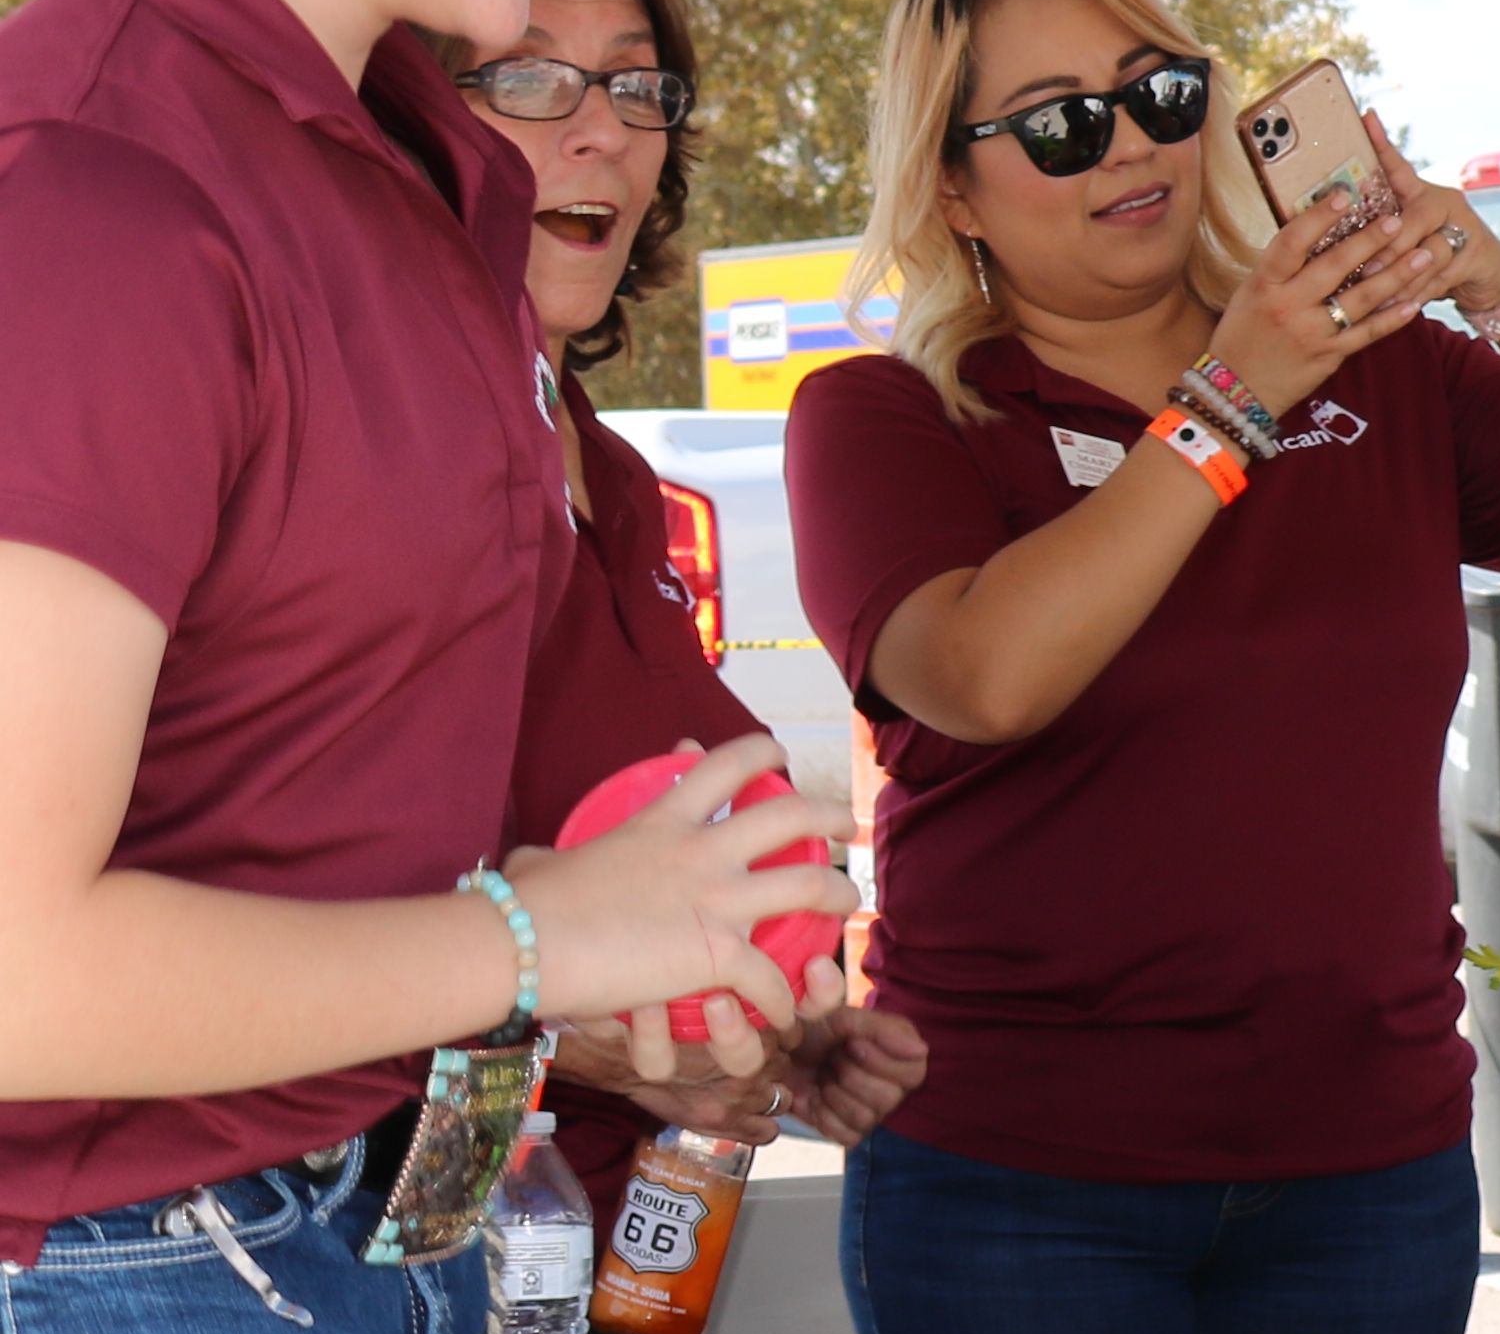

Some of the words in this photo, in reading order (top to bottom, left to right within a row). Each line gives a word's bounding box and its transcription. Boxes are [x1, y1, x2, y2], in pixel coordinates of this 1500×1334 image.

[632, 1188, 689, 1218] ROUTE
[623, 1212, 679, 1254] 66
[624, 1242, 664, 1265] SODAS
